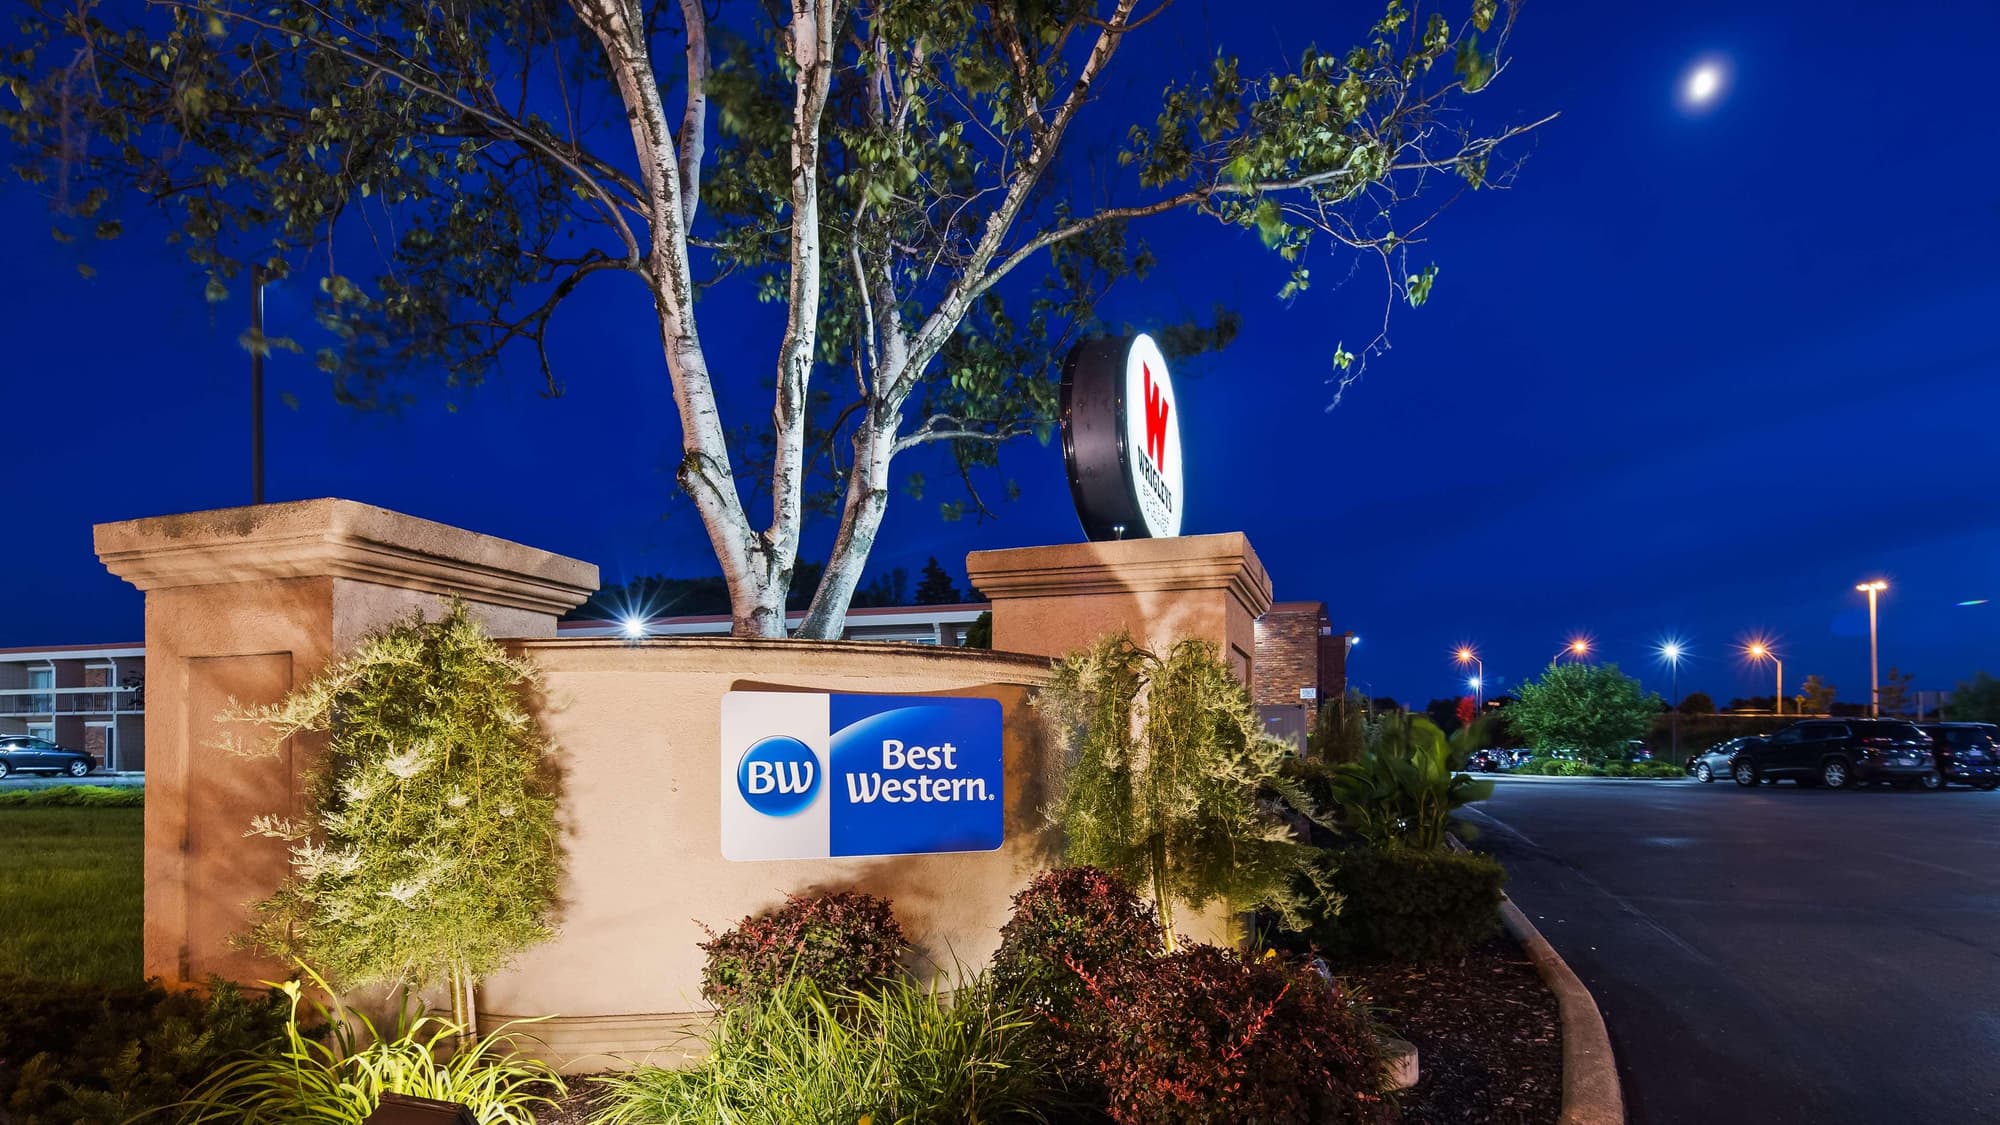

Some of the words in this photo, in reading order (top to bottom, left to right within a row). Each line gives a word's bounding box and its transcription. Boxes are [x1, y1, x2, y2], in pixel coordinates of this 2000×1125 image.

[1143, 359, 1169, 475] W
[1137, 444, 1172, 514] WRIGLEYS
[748, 760, 814, 794] BW
[882, 739, 957, 770] Best
